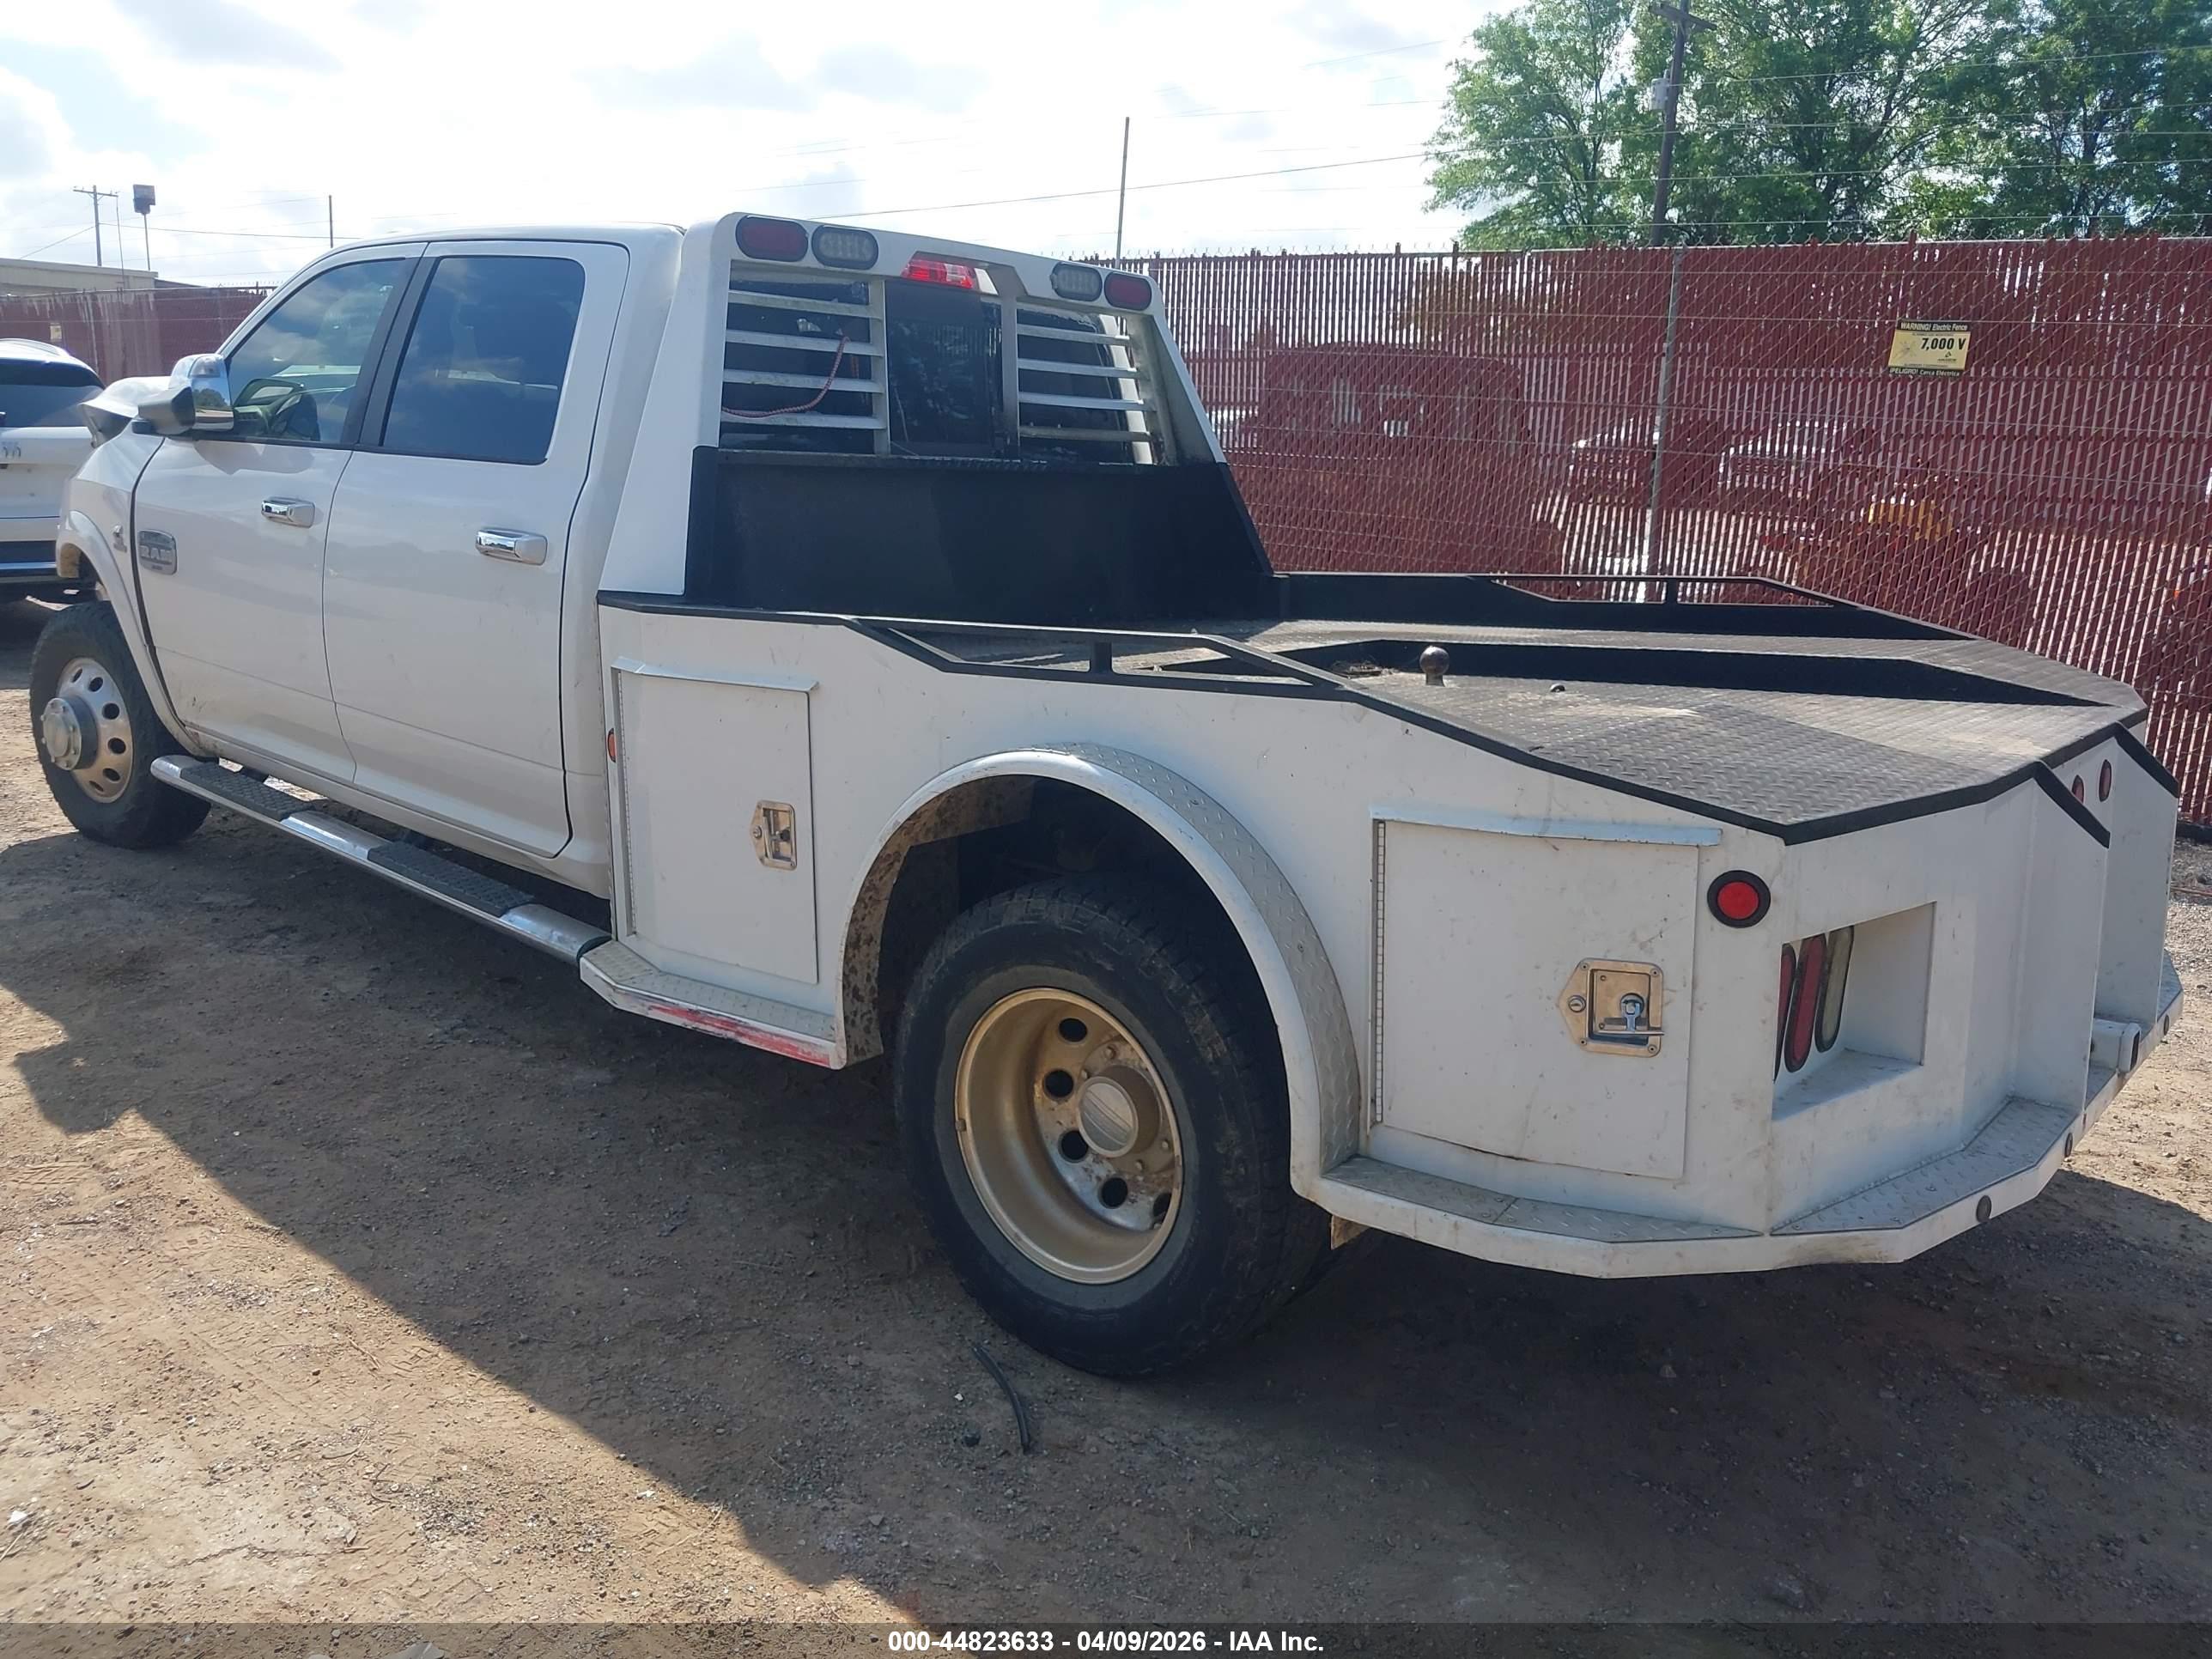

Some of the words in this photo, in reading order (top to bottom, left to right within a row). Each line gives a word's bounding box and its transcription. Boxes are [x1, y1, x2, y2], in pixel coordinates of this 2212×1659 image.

[1900, 322, 1931, 331] WARNING!
[1921, 337, 1954, 350] 7,000
[1958, 337, 1966, 350] V
[139, 544, 173, 562] RAM
